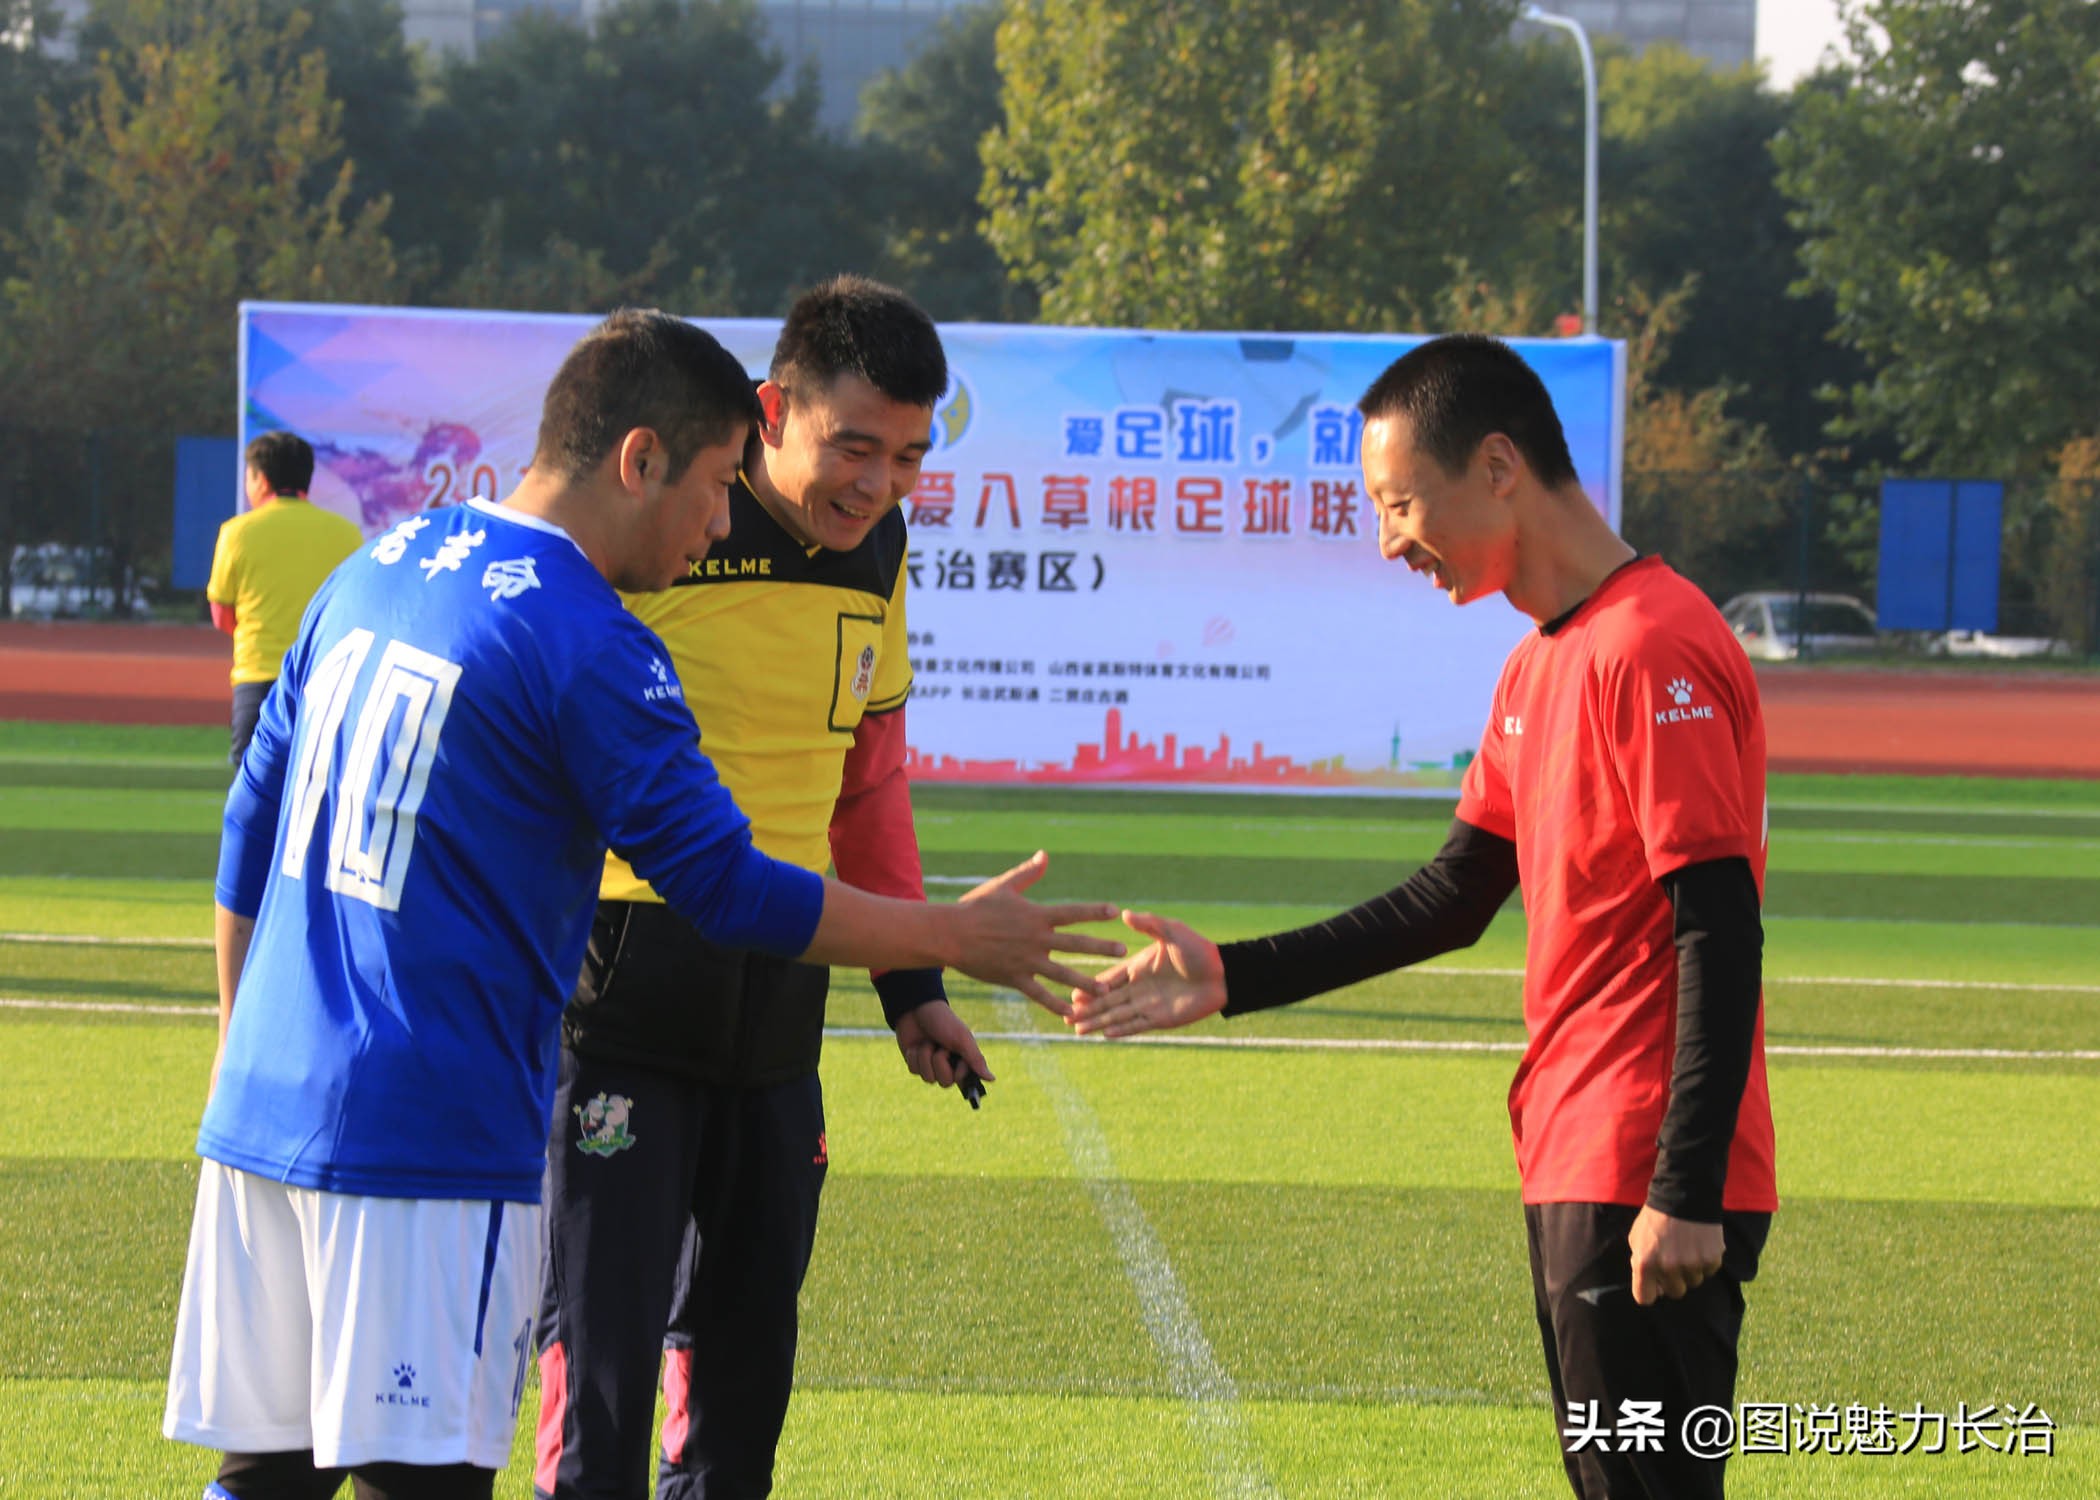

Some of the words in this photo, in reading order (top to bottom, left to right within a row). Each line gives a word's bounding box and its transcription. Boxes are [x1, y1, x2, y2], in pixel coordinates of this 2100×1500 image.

[429, 463, 529, 508] 20
[688, 558, 772, 577] KELME
[1655, 705, 1714, 725] KELME
[281, 626, 464, 913] 10
[375, 1392, 431, 1408] KELME
